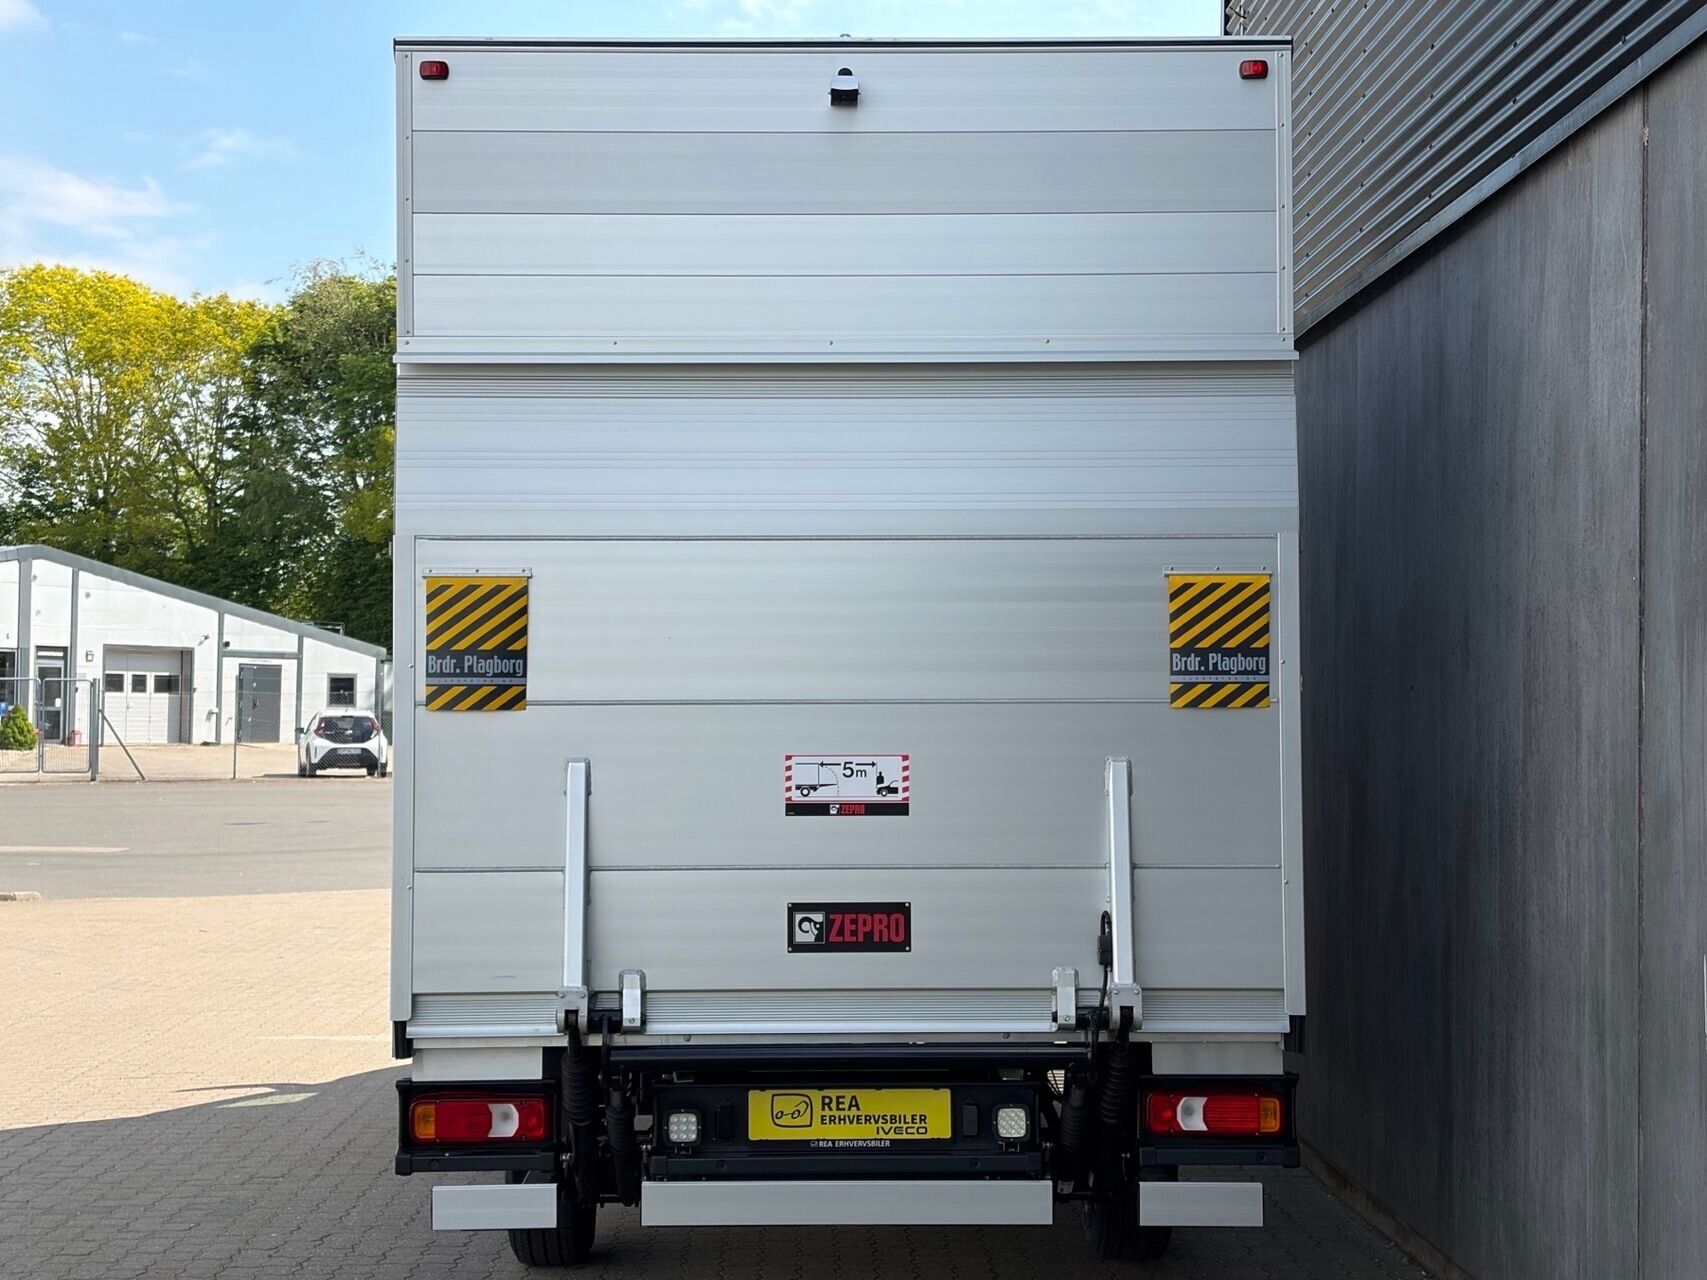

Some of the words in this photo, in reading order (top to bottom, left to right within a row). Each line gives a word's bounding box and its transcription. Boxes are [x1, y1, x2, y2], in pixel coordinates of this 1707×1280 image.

[428, 655, 460, 674] Brdr.
[464, 655, 524, 677] Plagborg
[1172, 653, 1205, 672] Brdr.
[1208, 653, 1266, 674] Plagborg
[841, 804, 865, 815] ZEPRO
[828, 912, 905, 943] ZEPRO
[821, 1095, 861, 1112] REA
[820, 1114, 928, 1126] ERHVERVSBILER
[876, 1126, 929, 1136] IVECO
[819, 1140, 833, 1148] REA
[835, 1140, 891, 1148] ERHVERVSBILER
